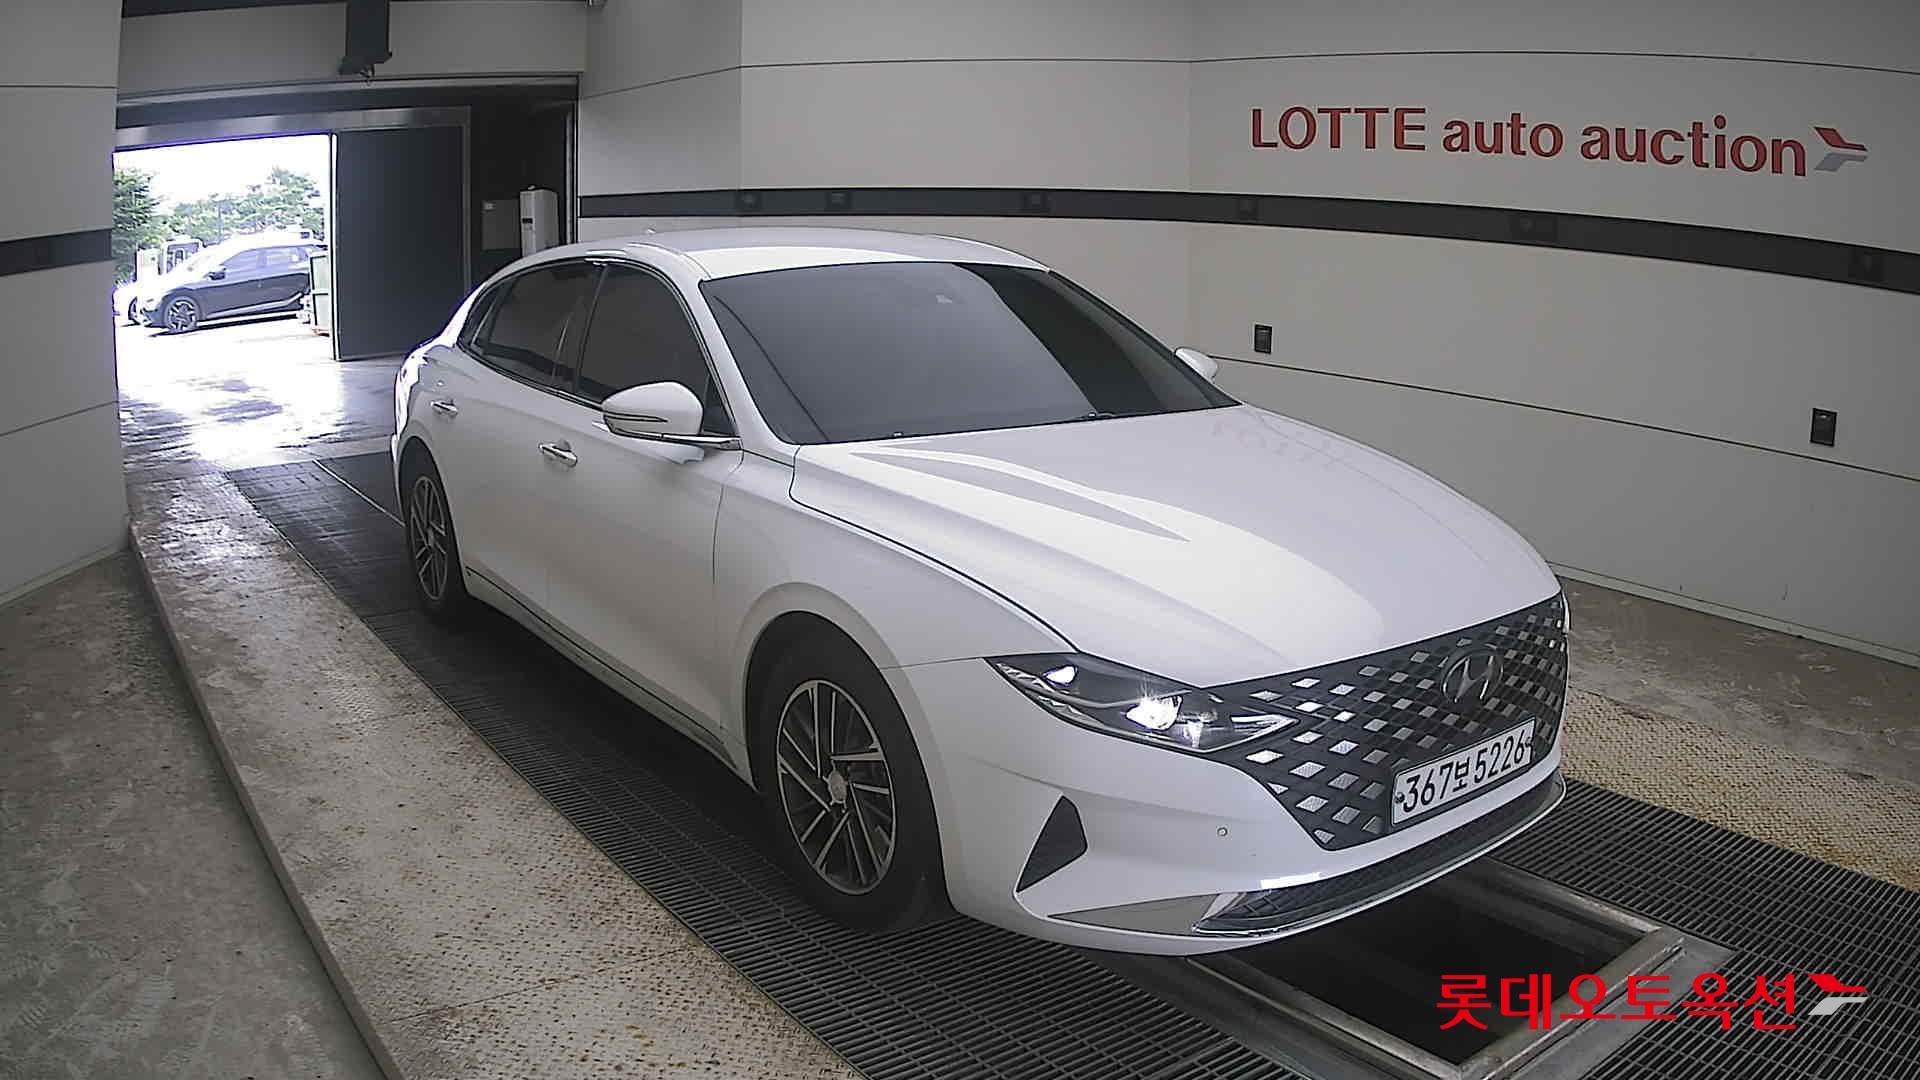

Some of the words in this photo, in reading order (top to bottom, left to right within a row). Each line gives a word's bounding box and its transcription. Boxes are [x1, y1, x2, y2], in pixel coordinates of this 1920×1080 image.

[1251, 106, 1426, 151] LOTTE
[1442, 113, 1564, 158] auto
[1580, 115, 1807, 177] auction
